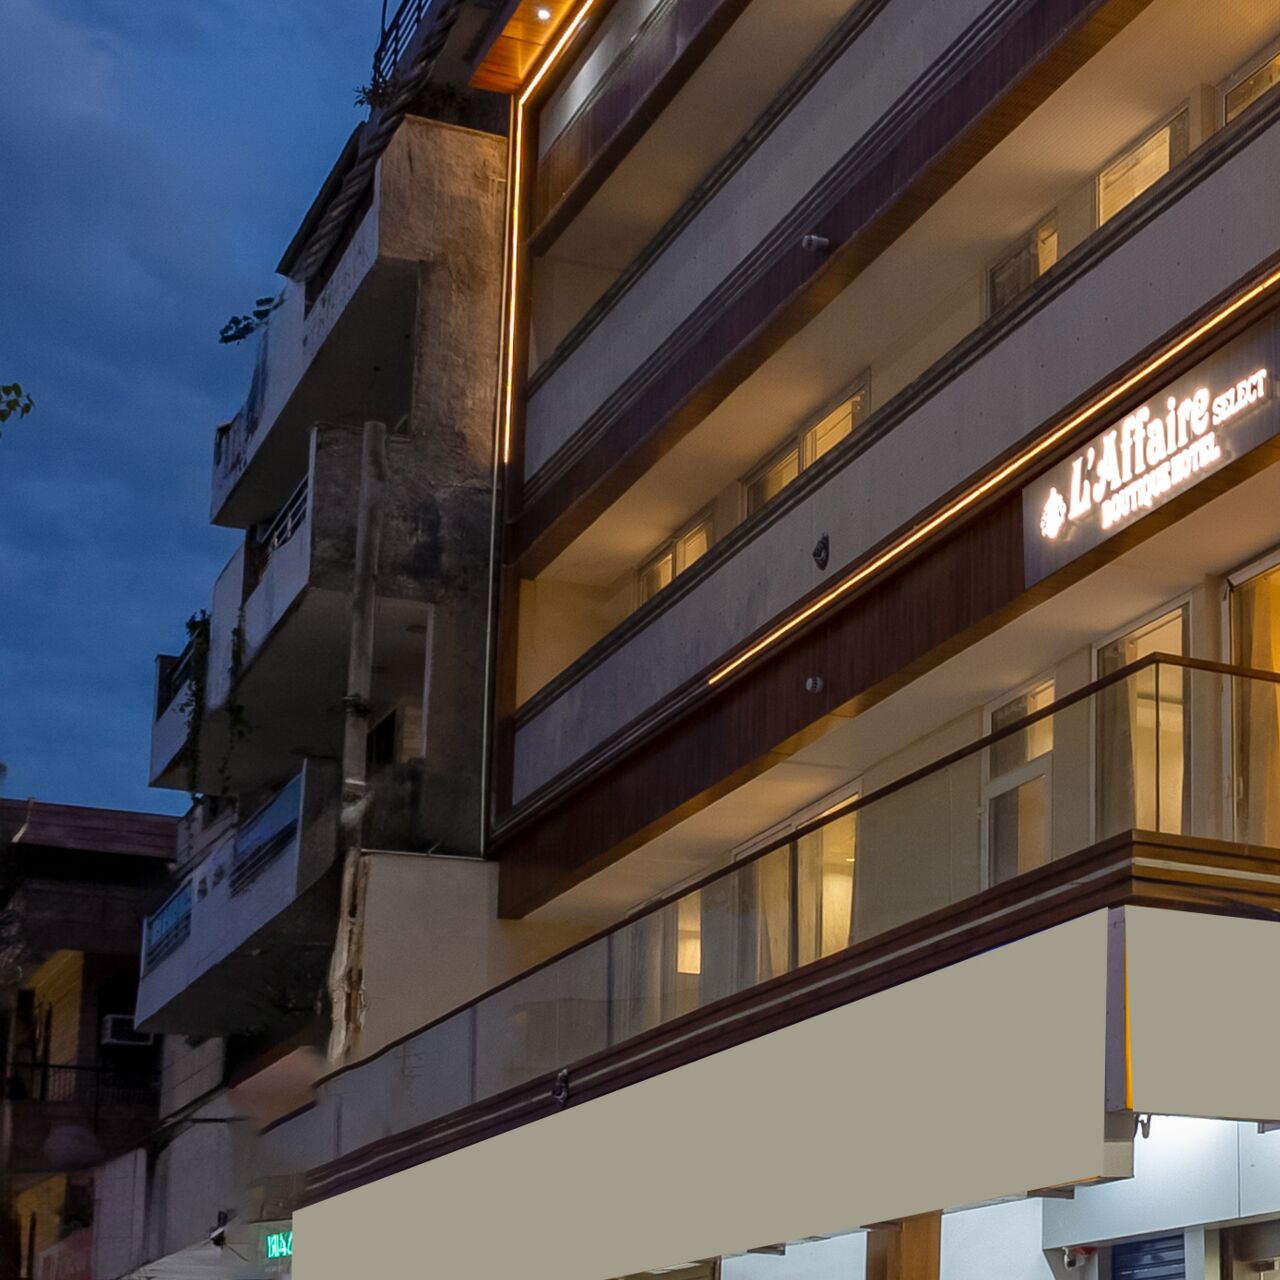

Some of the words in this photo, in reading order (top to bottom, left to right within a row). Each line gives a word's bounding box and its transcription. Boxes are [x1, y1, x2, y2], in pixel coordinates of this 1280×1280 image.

[1067, 387, 1210, 520] L'Affaire
[1212, 368, 1267, 426] SELECT
[1101, 461, 1171, 529] BOUTIQUE
[1170, 431, 1221, 485] HOTEL
